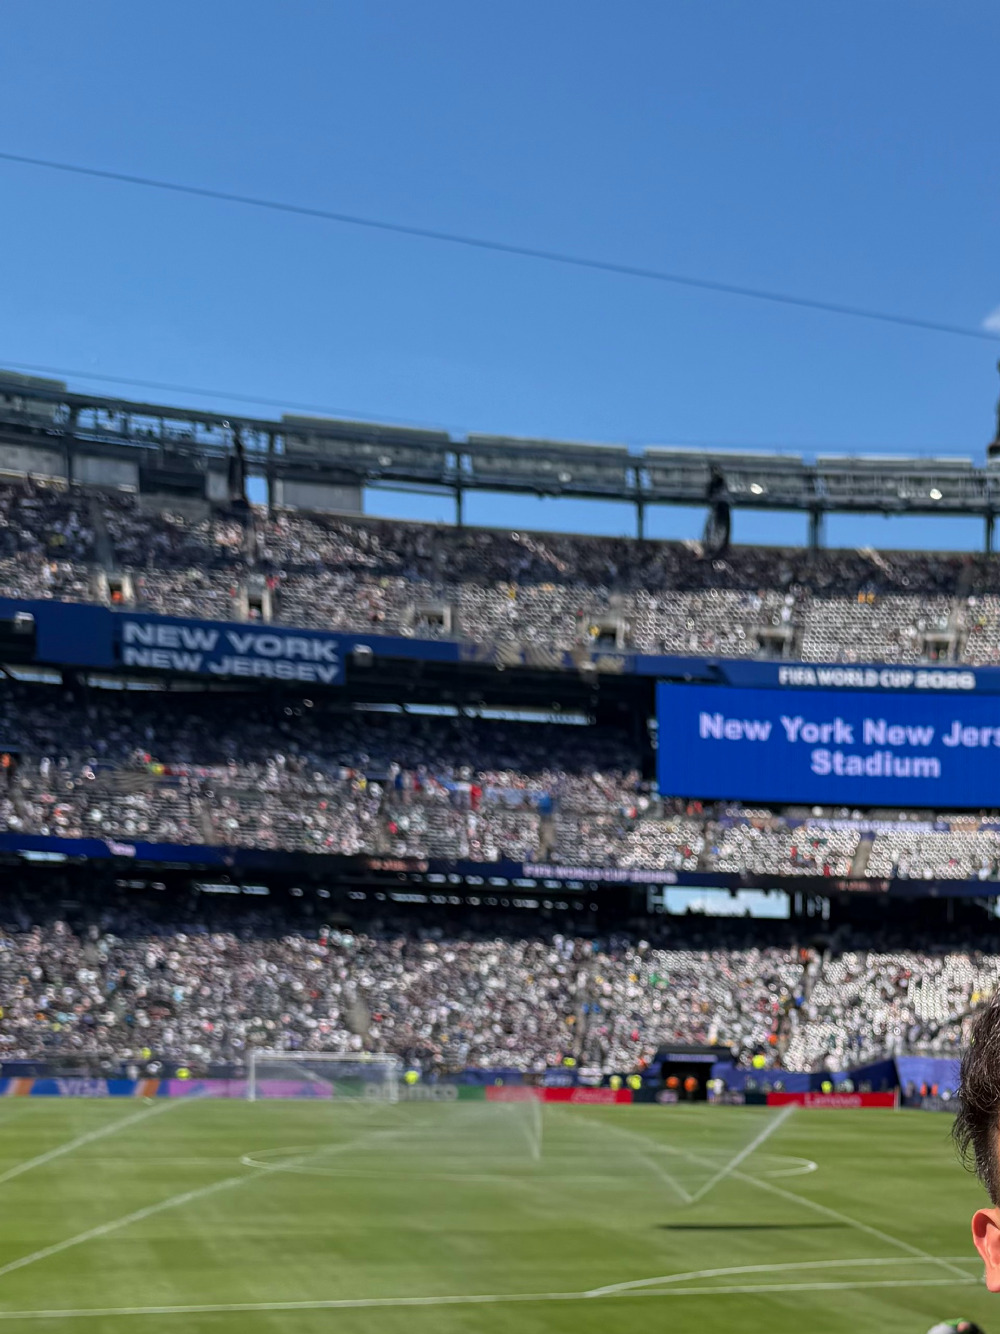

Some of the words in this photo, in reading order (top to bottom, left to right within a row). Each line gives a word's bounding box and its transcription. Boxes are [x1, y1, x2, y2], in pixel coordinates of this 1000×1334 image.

[123, 621, 219, 651] NEW
[226, 632, 338, 662] YORK
[123, 647, 201, 671] NEW
[207, 654, 338, 684] JERSEY
[779, 666, 817, 686] FIFA
[817, 667, 879, 687] WORLD
[879, 669, 914, 688] CUP
[915, 670, 976, 690] 2026
[700, 712, 772, 741] New
[780, 715, 854, 744] York
[863, 718, 934, 746] New
[810, 748, 942, 778] Stadium
